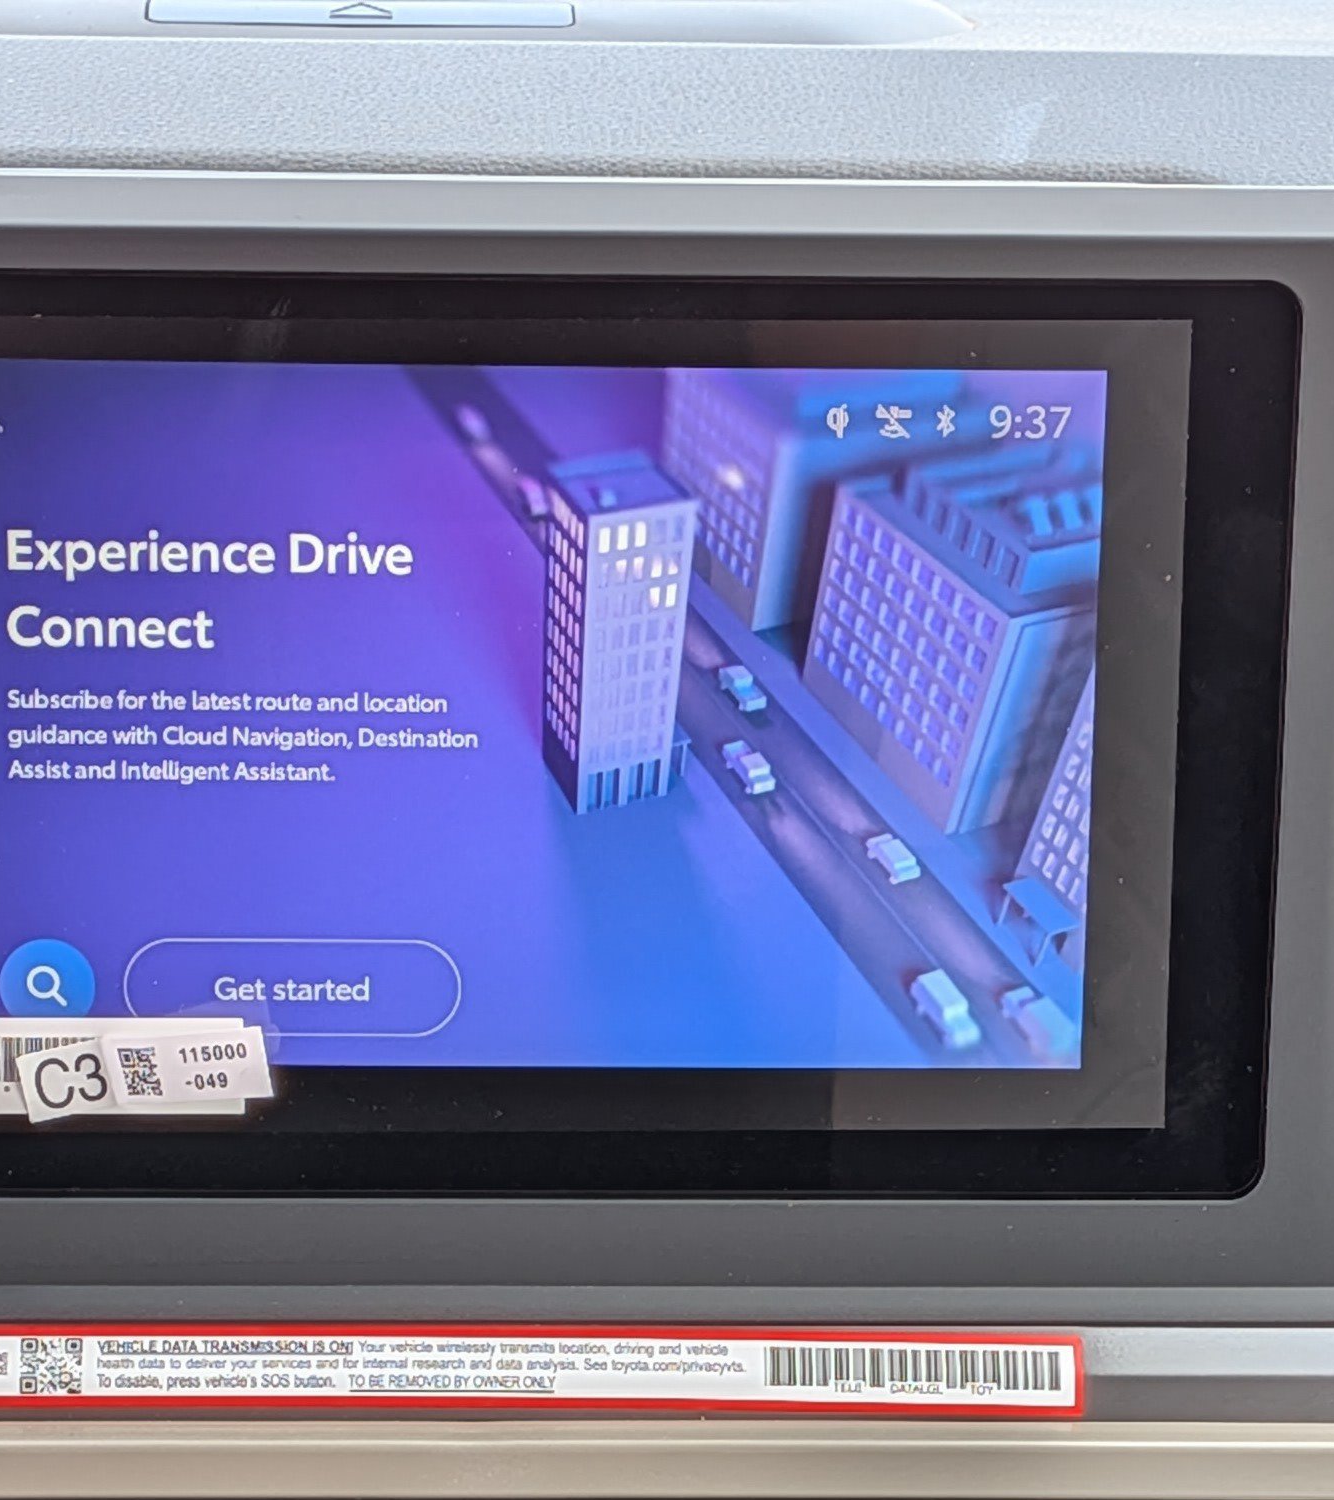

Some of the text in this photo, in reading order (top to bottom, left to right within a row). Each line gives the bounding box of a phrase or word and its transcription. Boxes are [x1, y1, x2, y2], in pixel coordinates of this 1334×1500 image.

[989, 405, 1072, 439] 9:37
[6, 529, 414, 581] Experience Drive
[6, 604, 215, 649] Connect
[7, 689, 448, 713] Subscribe for the latest route and location
[7, 725, 479, 750] guidance with Cloud Navigation, Destination
[8, 760, 336, 785] Assist and Intelligent Assistant.
[214, 976, 370, 1002] Get started
[178, 1043, 247, 1064] 115000
[34, 1052, 109, 1109] C3
[184, 1071, 229, 1091] -049
[97, 1340, 157, 1355] VEHICLE
[162, 1340, 198, 1355] DATA
[201, 1340, 308, 1355] TRANSMISSION
[312, 1340, 325, 1355] IS
[358, 1340, 387, 1353] Your
[389, 1340, 433, 1354] vehicle
[436, 1341, 496, 1356] wirelessly
[499, 1342, 555, 1355] transmits
[613, 1341, 654, 1359] driving
[658, 1342, 681, 1356] and
[685, 1342, 728, 1357] vehicle
[97, 1357, 134, 1370] health
[138, 1357, 165, 1370] data
[170, 1357, 182, 1370] to
[185, 1357, 227, 1370] deliver
[230, 1359, 256, 1373] your
[315, 1358, 339, 1370] and
[342, 1357, 359, 1370] for
[411, 1357, 465, 1371] research
[468, 1358, 492, 1371] and
[495, 1358, 523, 1371] data
[583, 1359, 607, 1372] See
[97, 1374, 112, 1389] To
[166, 1376, 202, 1391] press
[260, 1374, 290, 1389] SOS
[349, 1374, 365, 1389] TO
[368, 1374, 385, 1389] BE
[388, 1374, 451, 1389] REMOVED
[454, 1375, 470, 1389] BY
[472, 1375, 520, 1389] OWNER
[523, 1376, 556, 1389] ONLY
